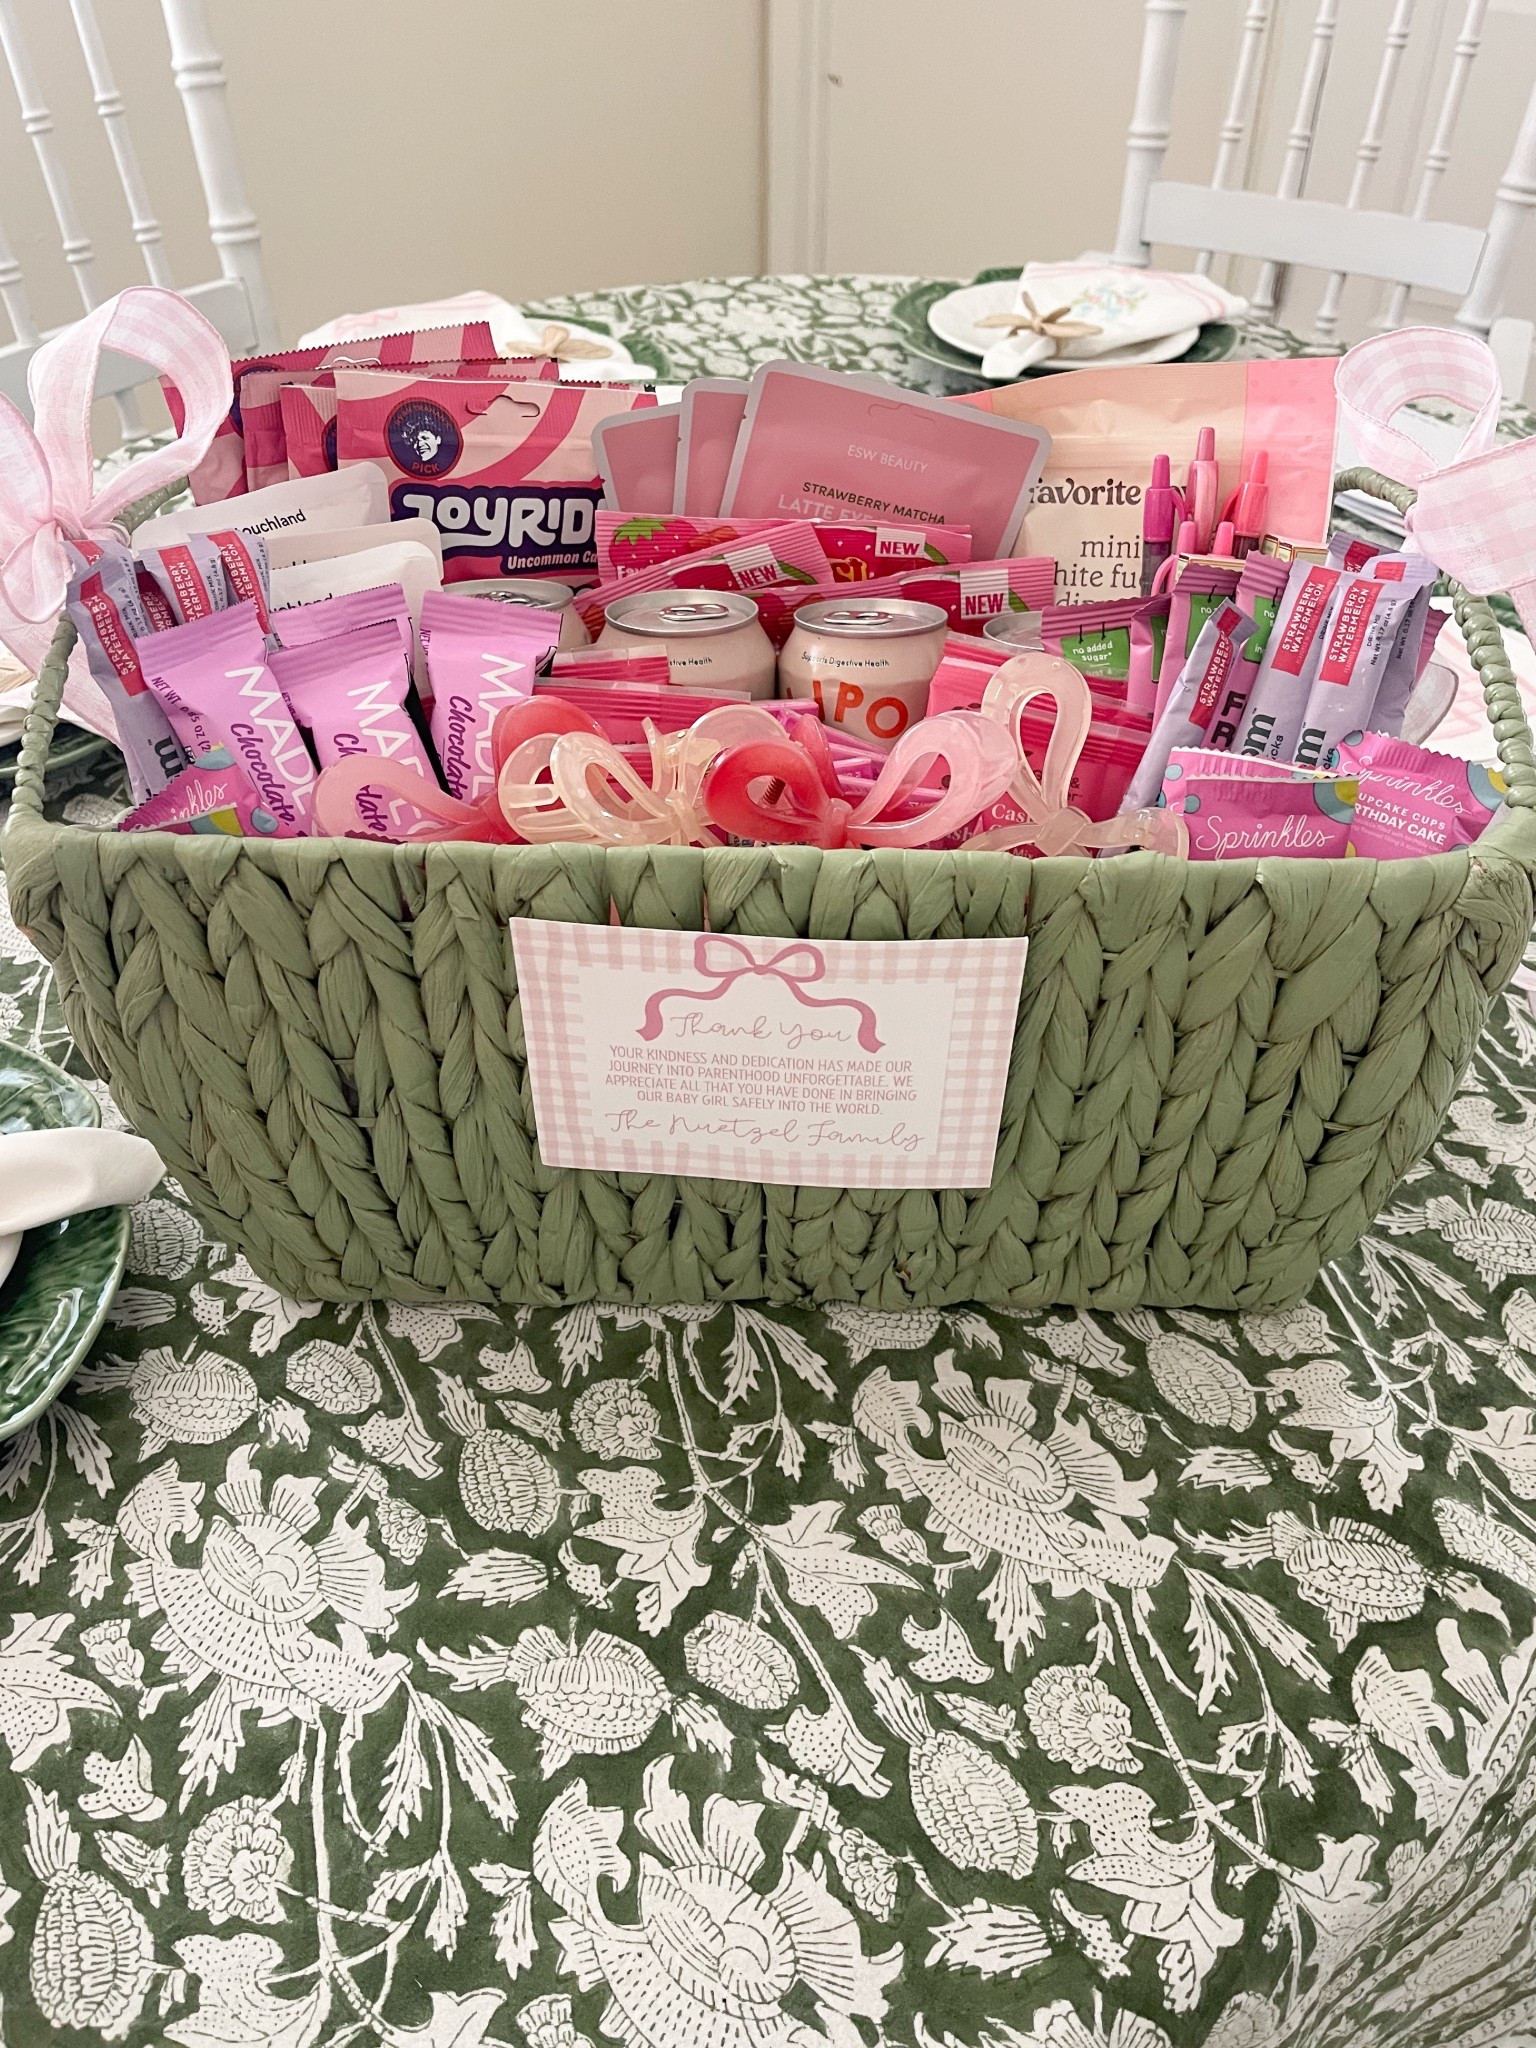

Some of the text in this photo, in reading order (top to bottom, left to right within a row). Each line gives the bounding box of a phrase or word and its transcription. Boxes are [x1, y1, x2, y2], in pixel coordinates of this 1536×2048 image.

[411, 461, 439, 474] PICK
[848, 445, 928, 473] ESW BEAUTY
[777, 493, 834, 520] LATTE
[802, 481, 945, 525] STRAWBERRY MATCHA
[235, 508, 307, 536] ouchland
[402, 493, 605, 550] JOYRID
[880, 541, 920, 556] NEW
[1080, 534, 1141, 559] mini
[507, 553, 580, 570] Uncommon
[737, 564, 778, 589] NEW
[1110, 563, 1143, 589] fu
[965, 593, 1004, 615] NEW
[1264, 610, 1275, 618] no
[1282, 581, 1316, 651] STRAWBERRY
[1290, 584, 1325, 653] WATERMELON
[1329, 587, 1360, 661] STRAWBERRY
[1338, 588, 1370, 663] WATERMELON
[84, 600, 130, 676] STRAWBERRY
[92, 595, 137, 673] WATERMELON
[1086, 640, 1113, 653] added
[687, 657, 713, 666] Health
[828, 656, 863, 667] Digestive
[864, 659, 890, 667] Health
[151, 676, 169, 692] NET
[164, 689, 182, 705] WT
[194, 724, 206, 740] OZ
[787, 679, 909, 739] IPO
[1407, 823, 1447, 846] CAKE
[1412, 812, 1446, 831] CUPS
[1196, 814, 1335, 861] Sprinkles
[669, 1011, 773, 1040] Thank
[609, 1045, 913, 1073] YOUR KINDNESS AND DEDICATION HAS MADE OUR
[605, 1074, 917, 1101] APPRECIATE ALL THAT YOU HAVE DONE IN BRINGING
[609, 1060, 914, 1088] JOURNEY INTO PARENTHOOD UNFORGETTABLE. WE
[637, 1090, 884, 1115] OUR BABY GIRL SAFELY INTO THE WORLD.
[605, 1109, 661, 1132] The
[807, 1119, 926, 1152] Family
